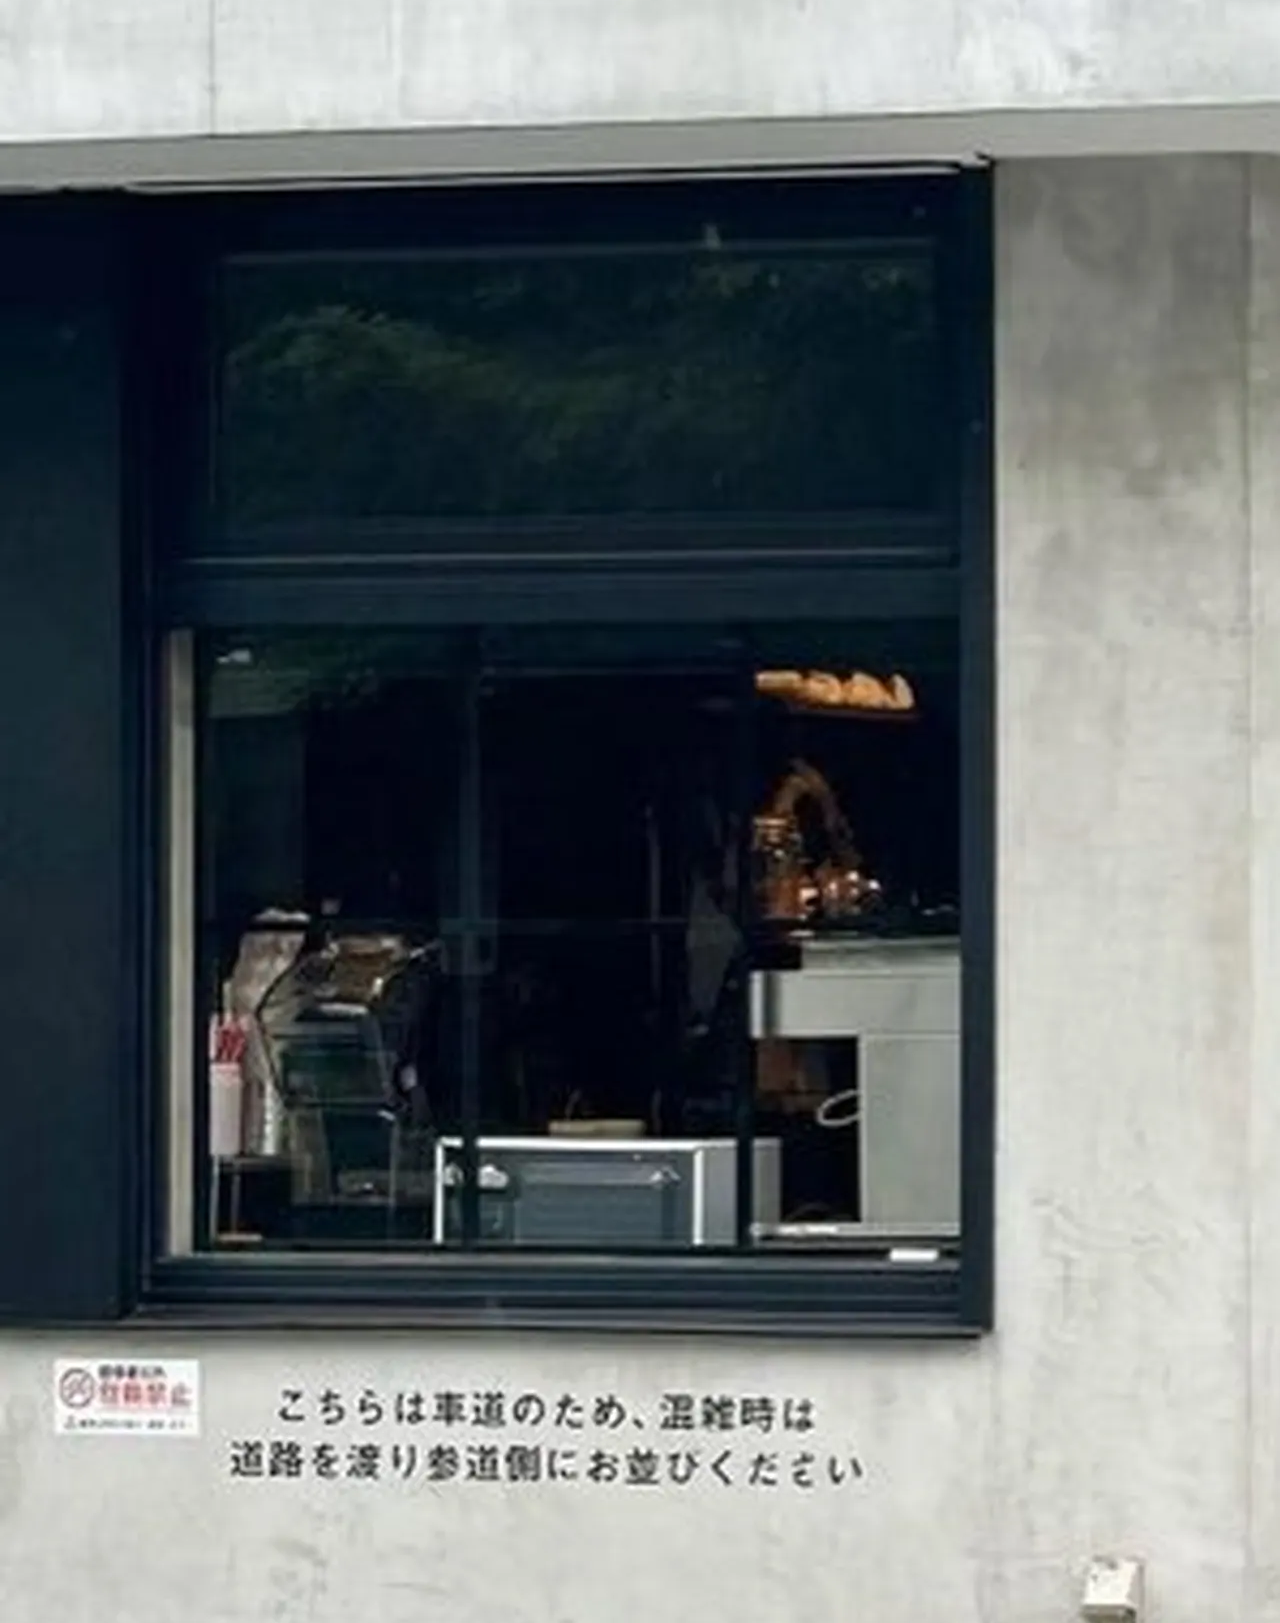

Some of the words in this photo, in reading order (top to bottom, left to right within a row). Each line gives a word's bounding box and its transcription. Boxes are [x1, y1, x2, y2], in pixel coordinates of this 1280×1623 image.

[277, 1388, 817, 1433] こちらは車道のため、混雑時は
[230, 1439, 865, 1488] 道路を渡り参道側にお並びください
